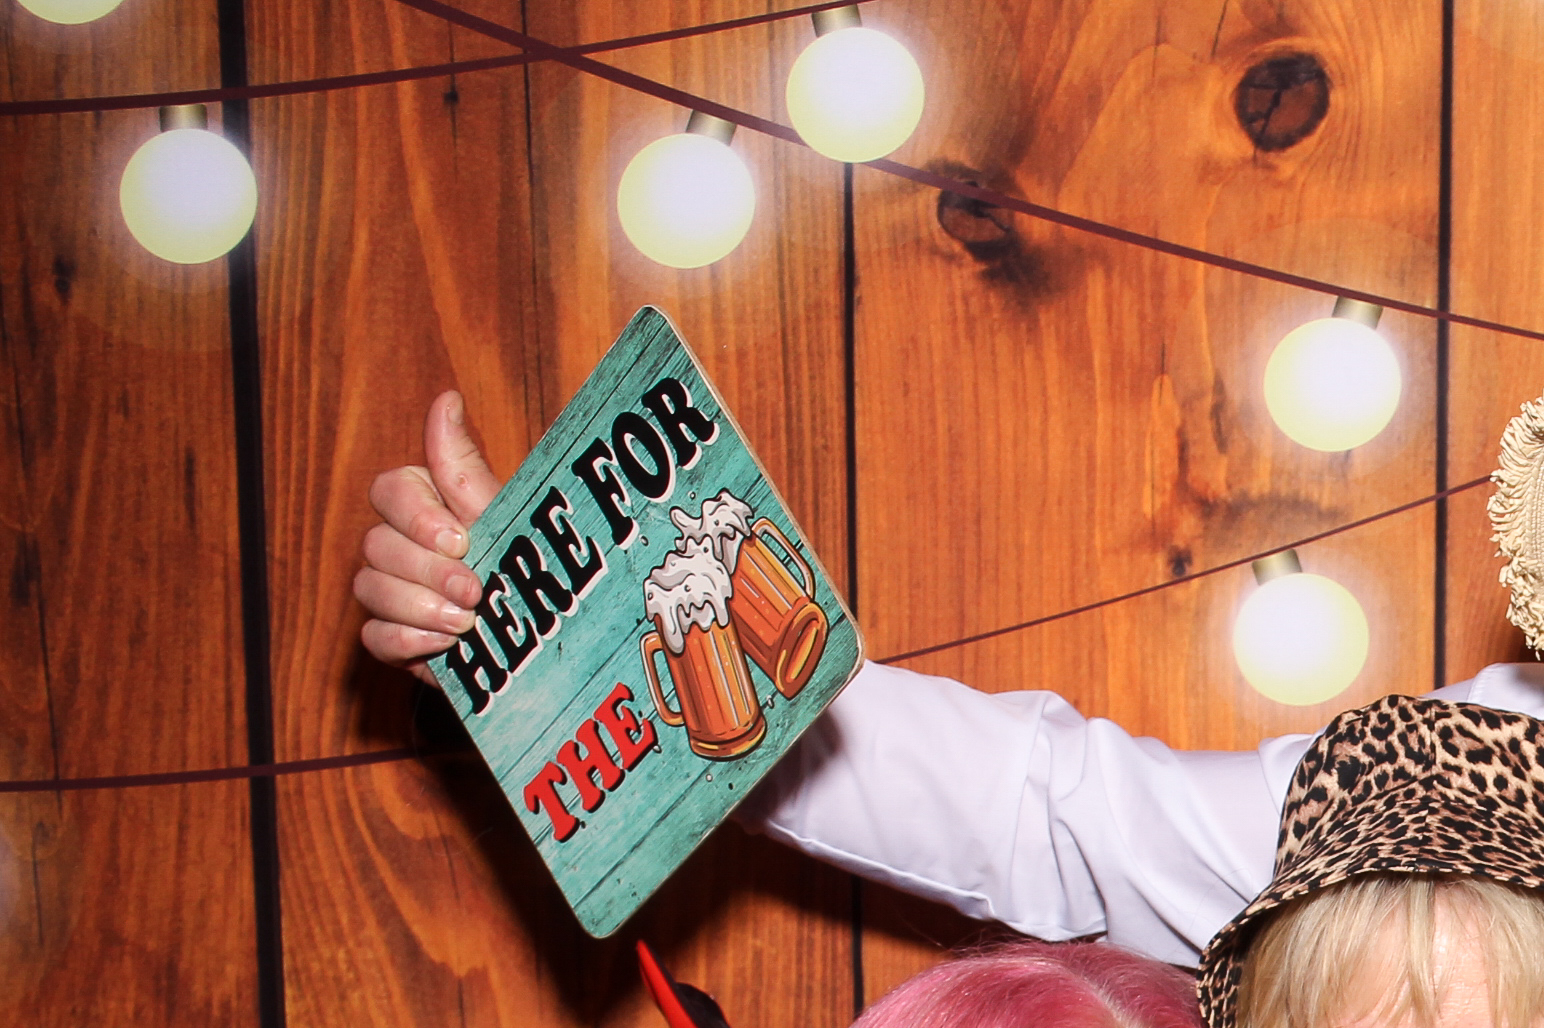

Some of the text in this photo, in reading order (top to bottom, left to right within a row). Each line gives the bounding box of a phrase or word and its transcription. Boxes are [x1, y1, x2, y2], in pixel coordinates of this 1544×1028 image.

[444, 377, 720, 716] HERE FOR
[523, 682, 660, 843] THE
